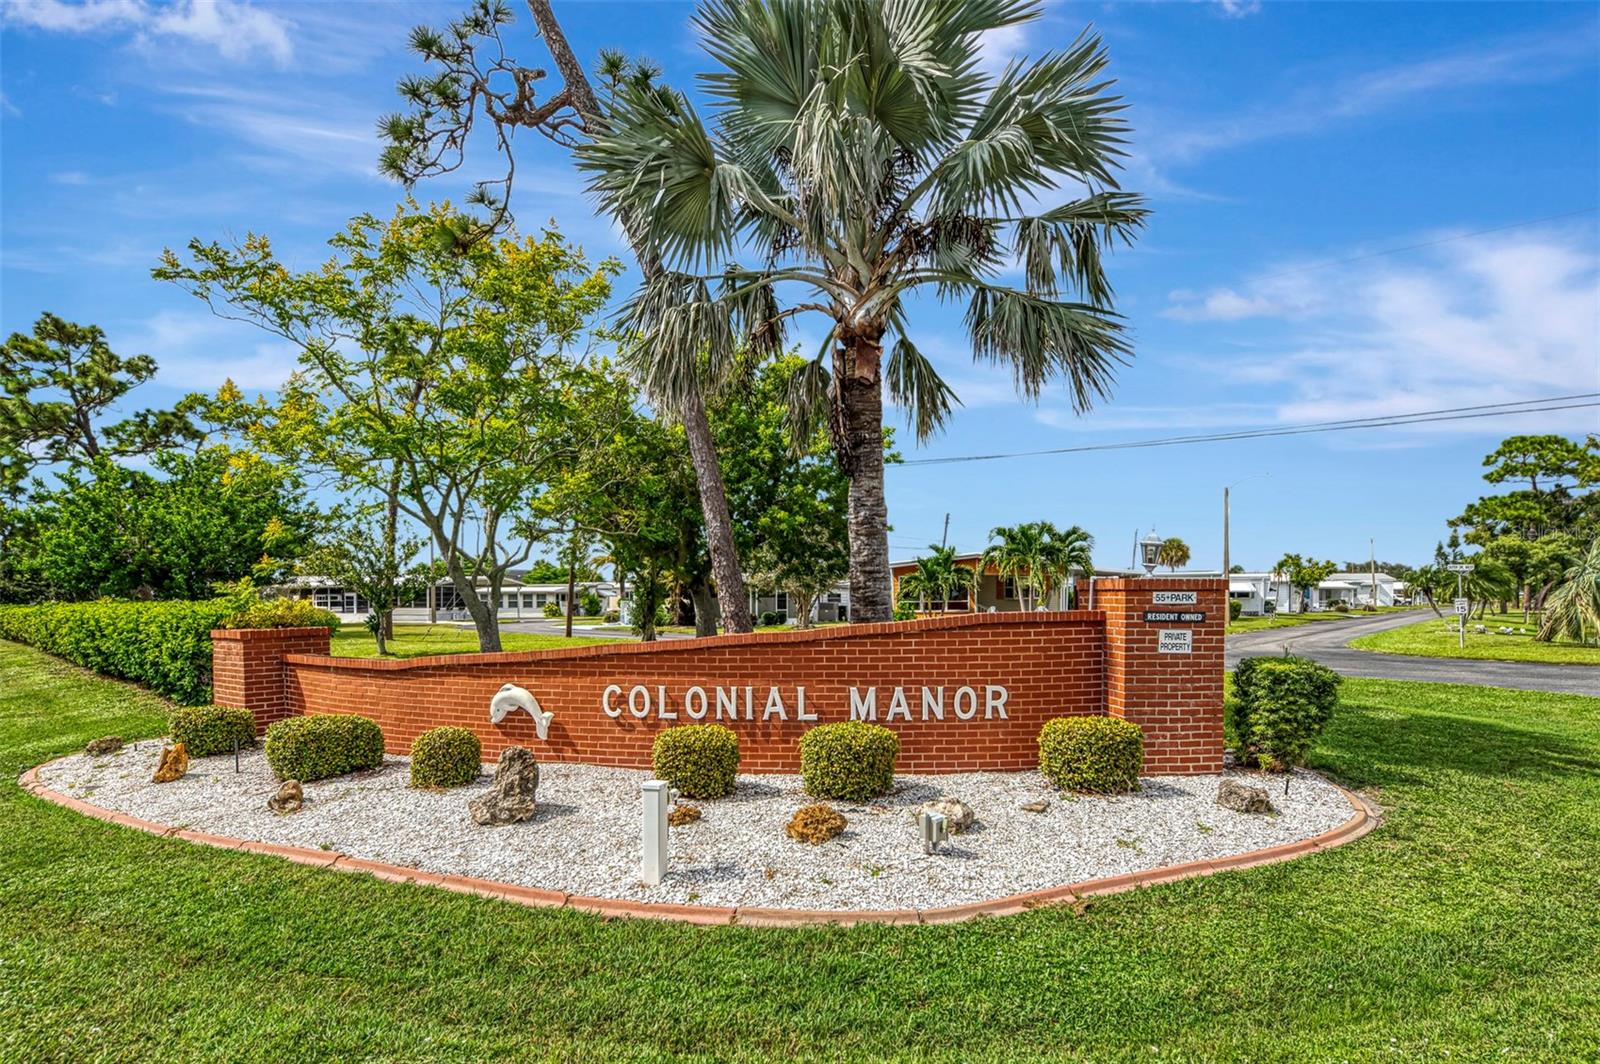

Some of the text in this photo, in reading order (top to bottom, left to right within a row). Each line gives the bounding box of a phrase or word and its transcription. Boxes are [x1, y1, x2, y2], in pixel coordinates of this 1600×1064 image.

[1164, 632, 1187, 641] PRIVATE
[1160, 642, 1190, 651] PROPERTY
[602, 684, 1009, 722] COLONIAL MANOR
